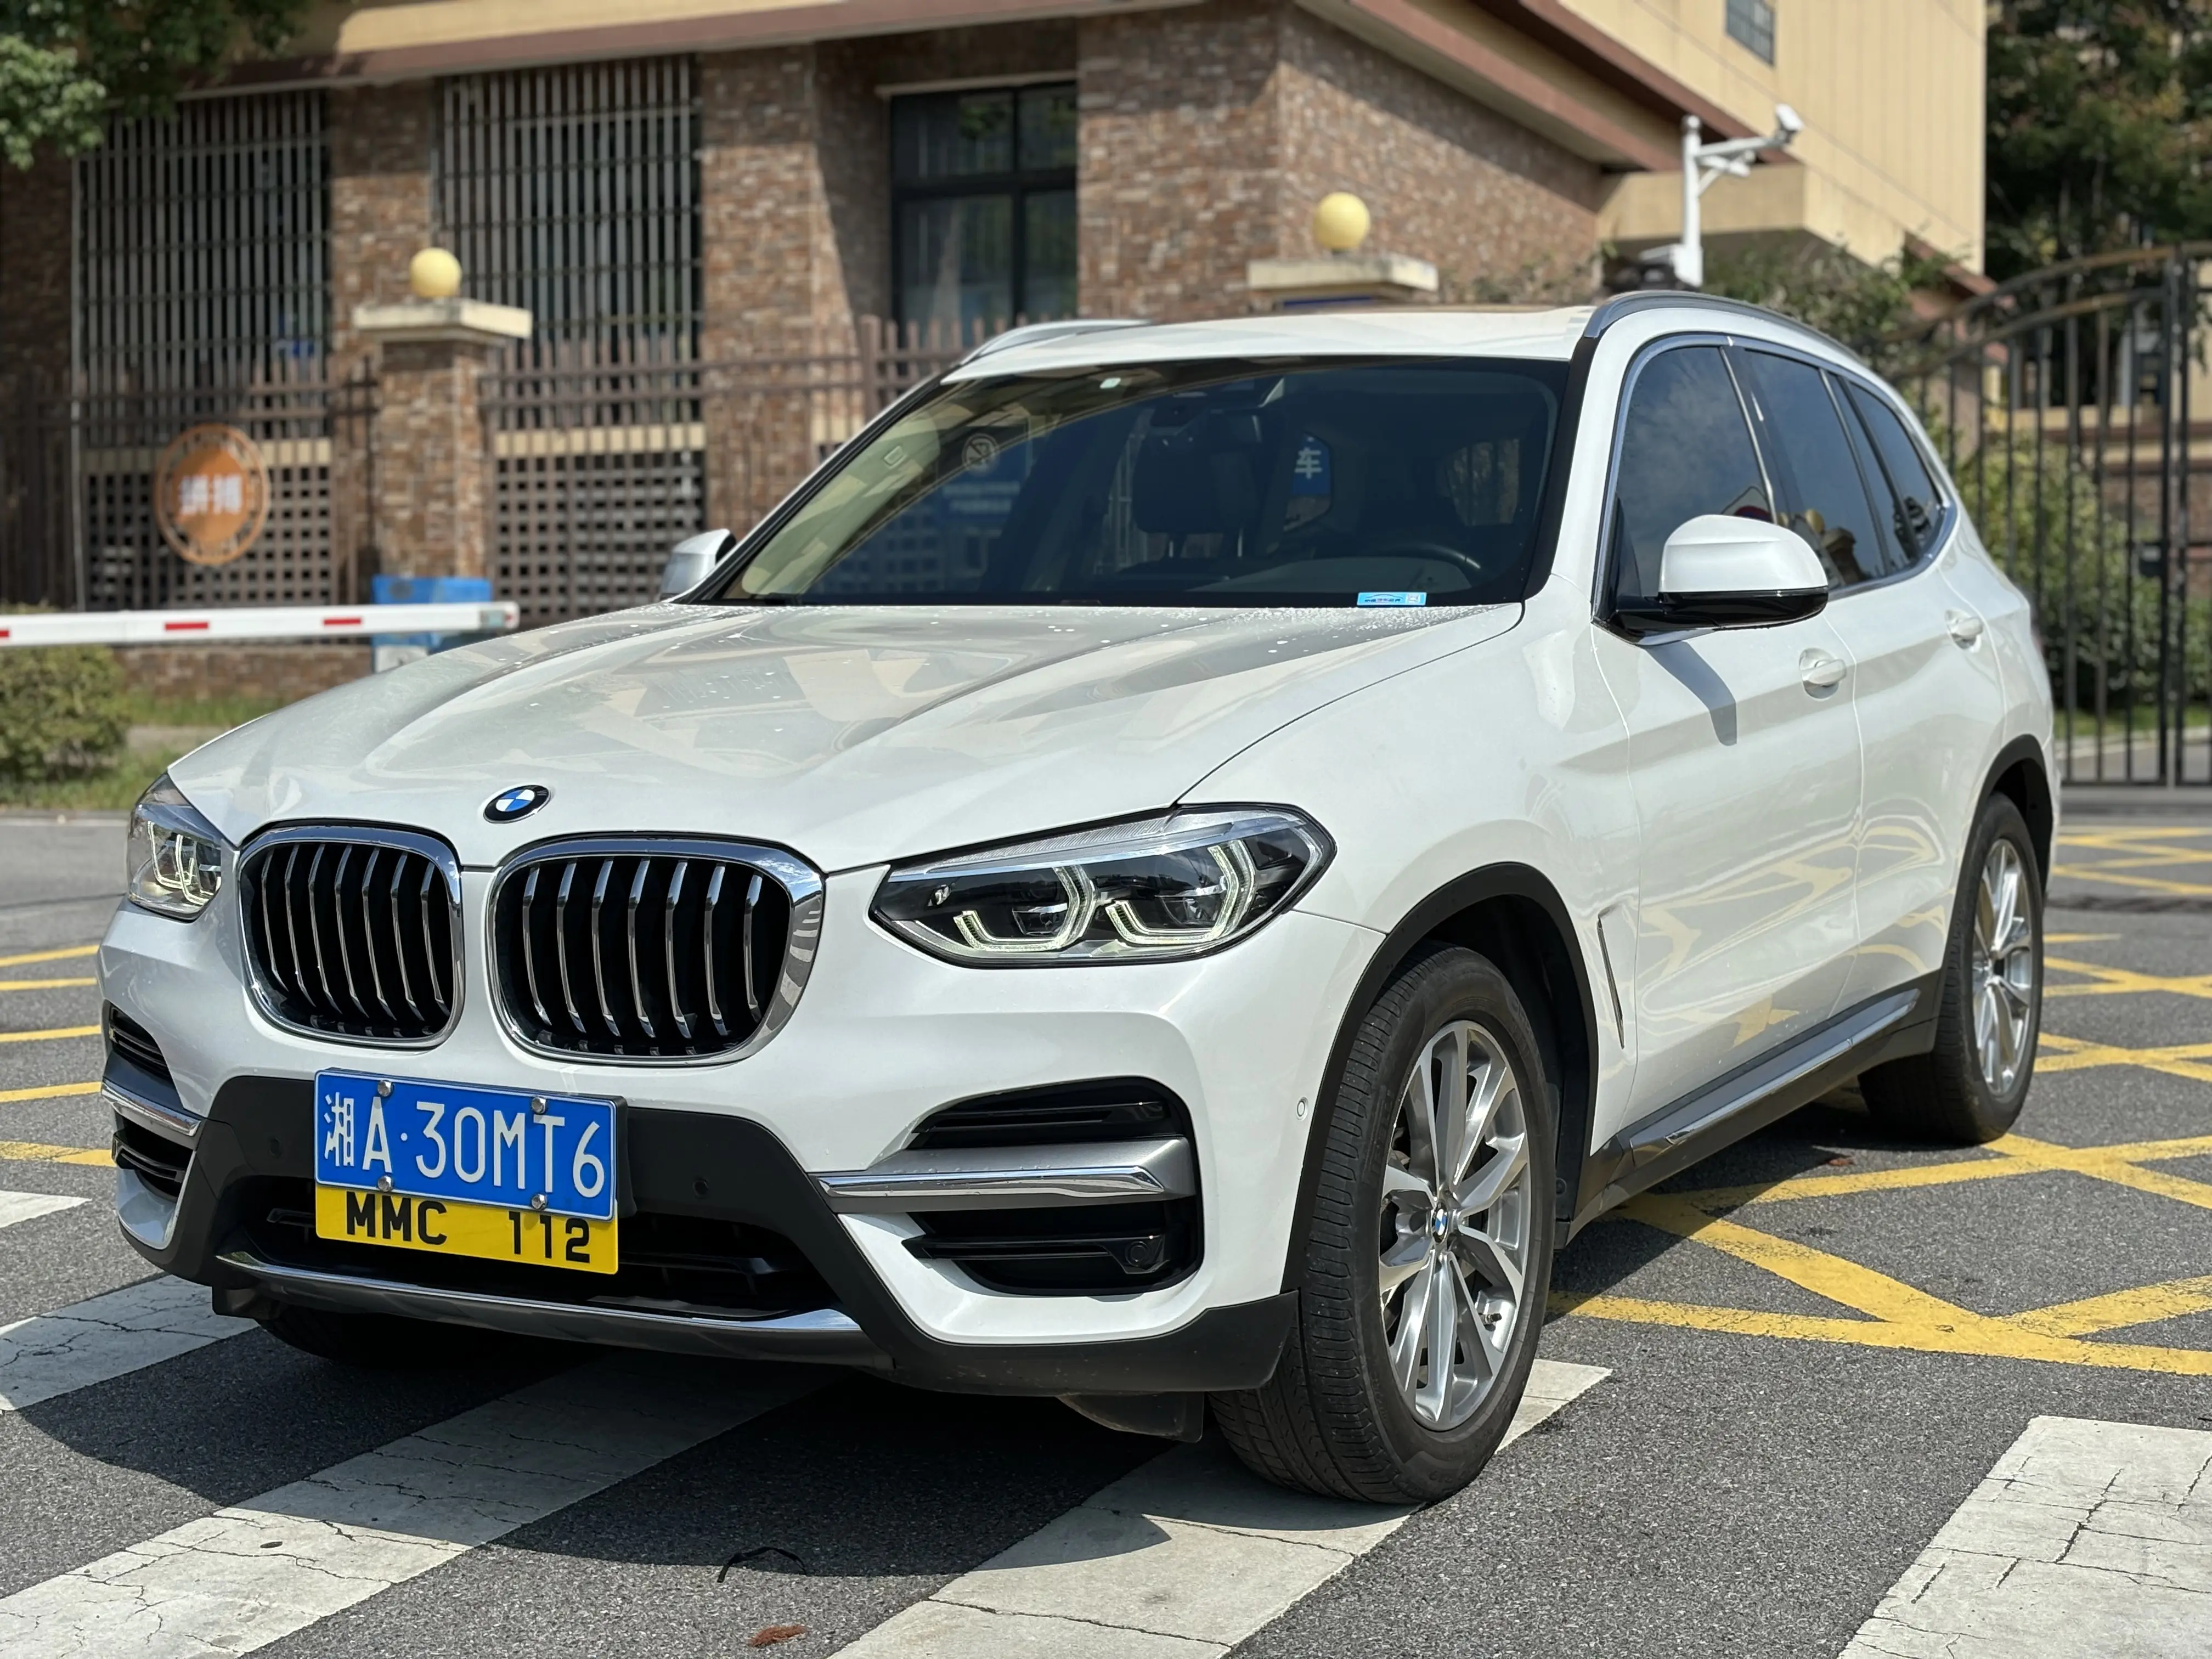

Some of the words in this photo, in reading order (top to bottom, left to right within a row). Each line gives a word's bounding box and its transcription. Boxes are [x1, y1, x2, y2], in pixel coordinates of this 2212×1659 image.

[1295, 447, 1322, 479] 车
[346, 1191, 447, 1245] MMC
[509, 1211, 590, 1263] 112
